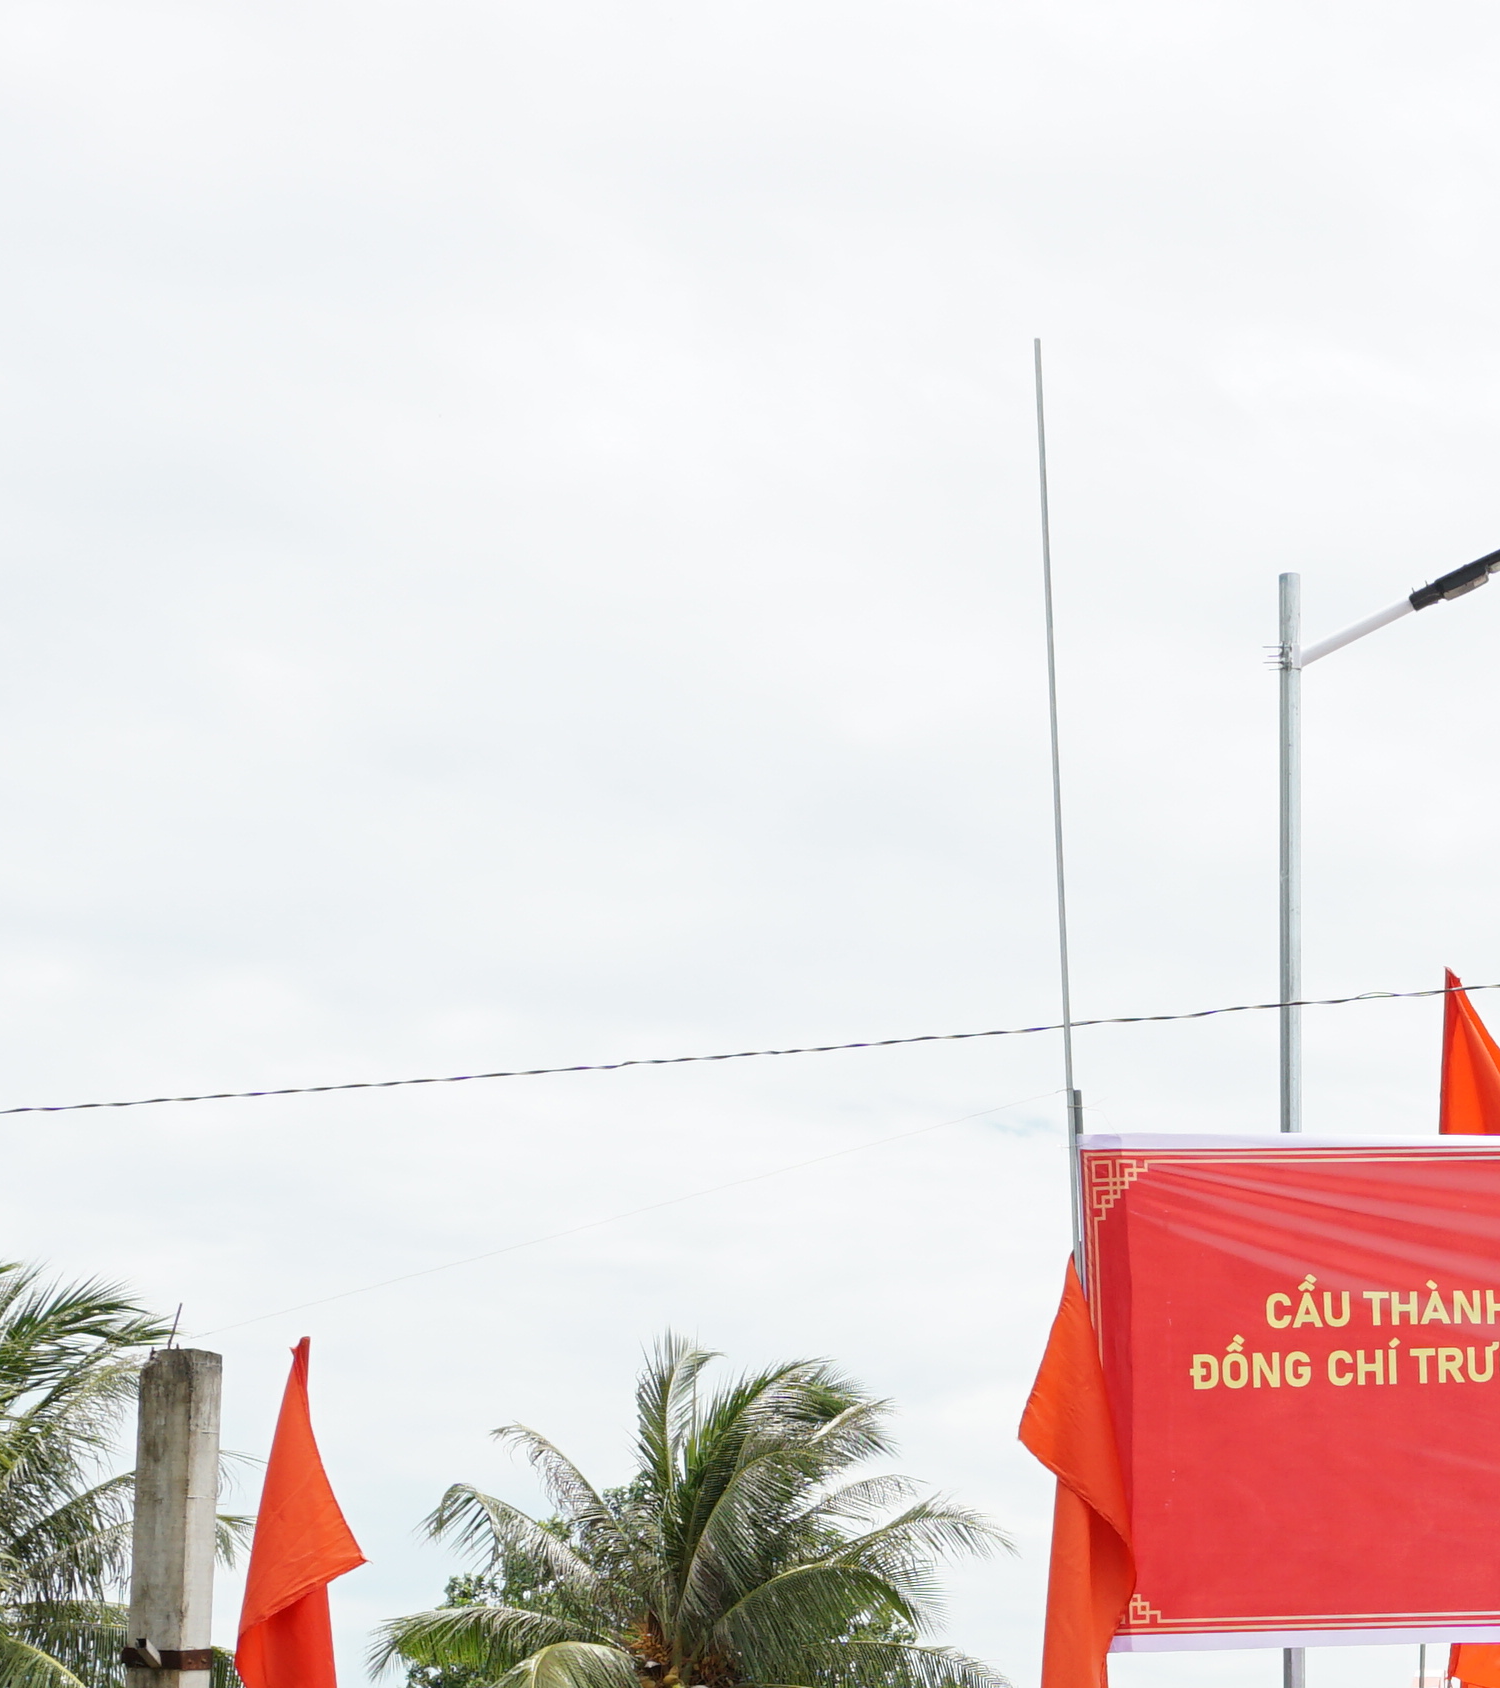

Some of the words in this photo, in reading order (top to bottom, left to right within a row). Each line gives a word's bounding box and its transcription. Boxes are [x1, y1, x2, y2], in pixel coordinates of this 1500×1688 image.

[1265, 1273, 1351, 1329] CẦU
[1189, 1334, 1312, 1390] ĐỒNG
[1327, 1337, 1401, 1387] CHÍ
